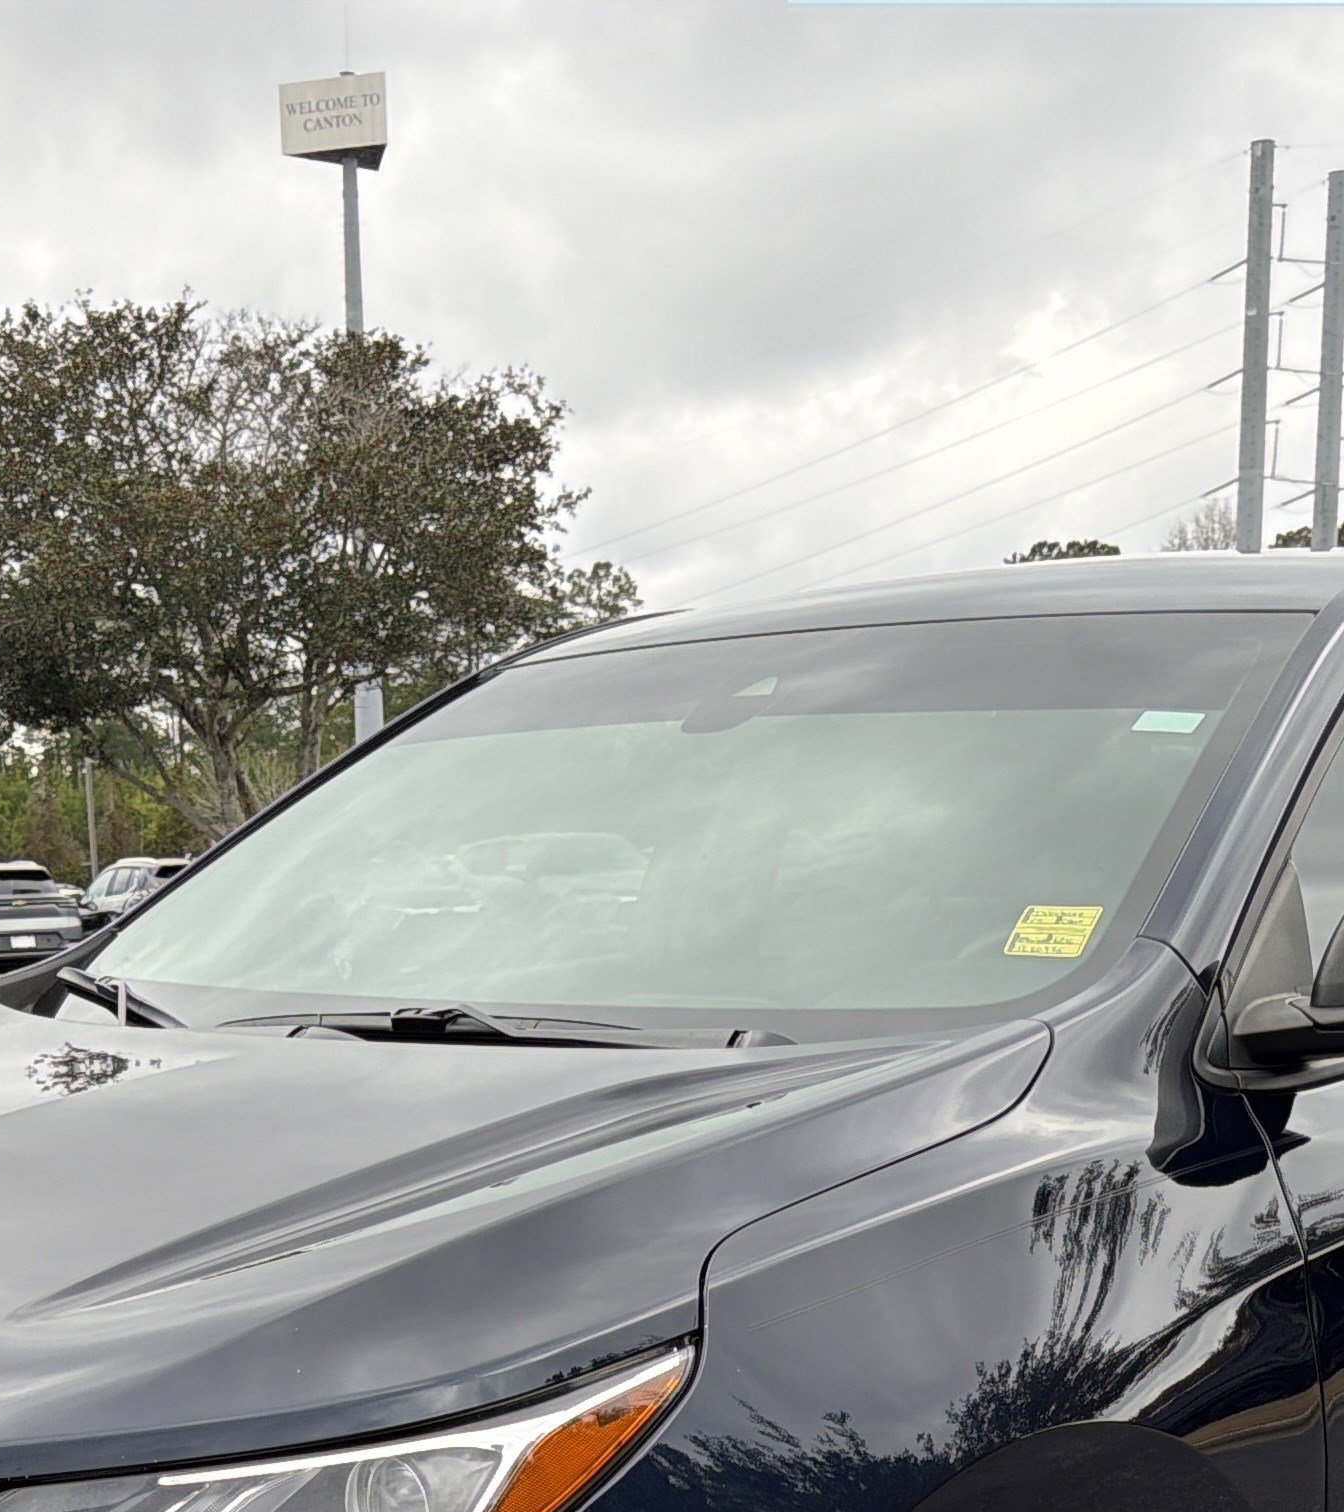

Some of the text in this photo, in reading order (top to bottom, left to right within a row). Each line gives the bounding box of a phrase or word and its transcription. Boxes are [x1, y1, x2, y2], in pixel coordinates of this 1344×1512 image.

[285, 93, 381, 116] WELCOME TO
[303, 112, 363, 132] CANTON
